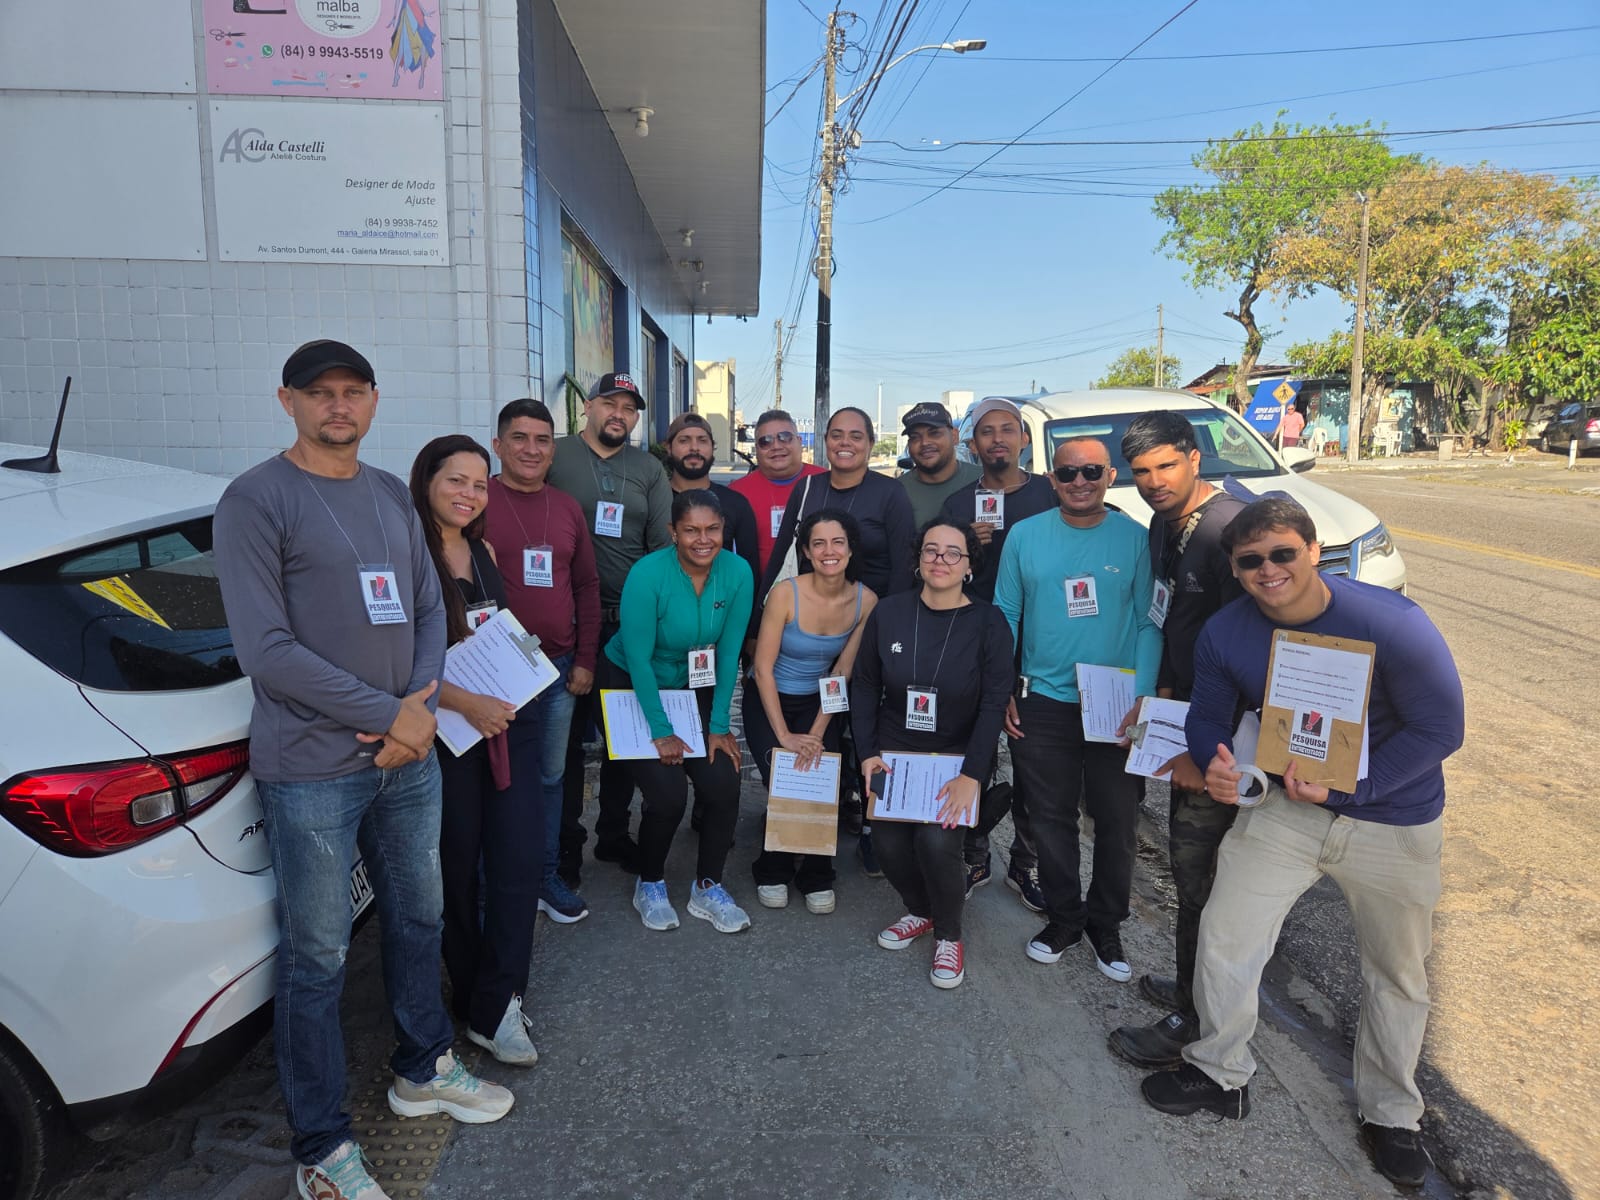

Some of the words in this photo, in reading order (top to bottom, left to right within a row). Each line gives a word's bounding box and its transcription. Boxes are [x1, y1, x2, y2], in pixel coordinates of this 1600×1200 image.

[316, 0, 360, 12] malba
[280, 45, 304, 60] (84)
[308, 46, 316, 57] 9
[319, 46, 384, 60] 9943-5519
[244, 139, 274, 152] Alda
[278, 140, 325, 153] Castelli
[295, 153, 327, 161] Costura
[345, 178, 389, 191] Designer
[391, 179, 404, 190] de
[406, 180, 436, 190] Moda
[404, 195, 436, 207] Ajuste
[365, 218, 382, 229] (84)
[384, 219, 390, 228] 9
[392, 219, 438, 228] 9938-7452
[257, 245, 270, 253] Av.
[271, 245, 297, 254] Santos
[298, 246, 329, 255] Dumont,
[330, 247, 345, 255] 444
[351, 247, 378, 255] Galeria
[369, 602, 401, 611] PESQUISA
[1292, 733, 1327, 749] PESQUISA
